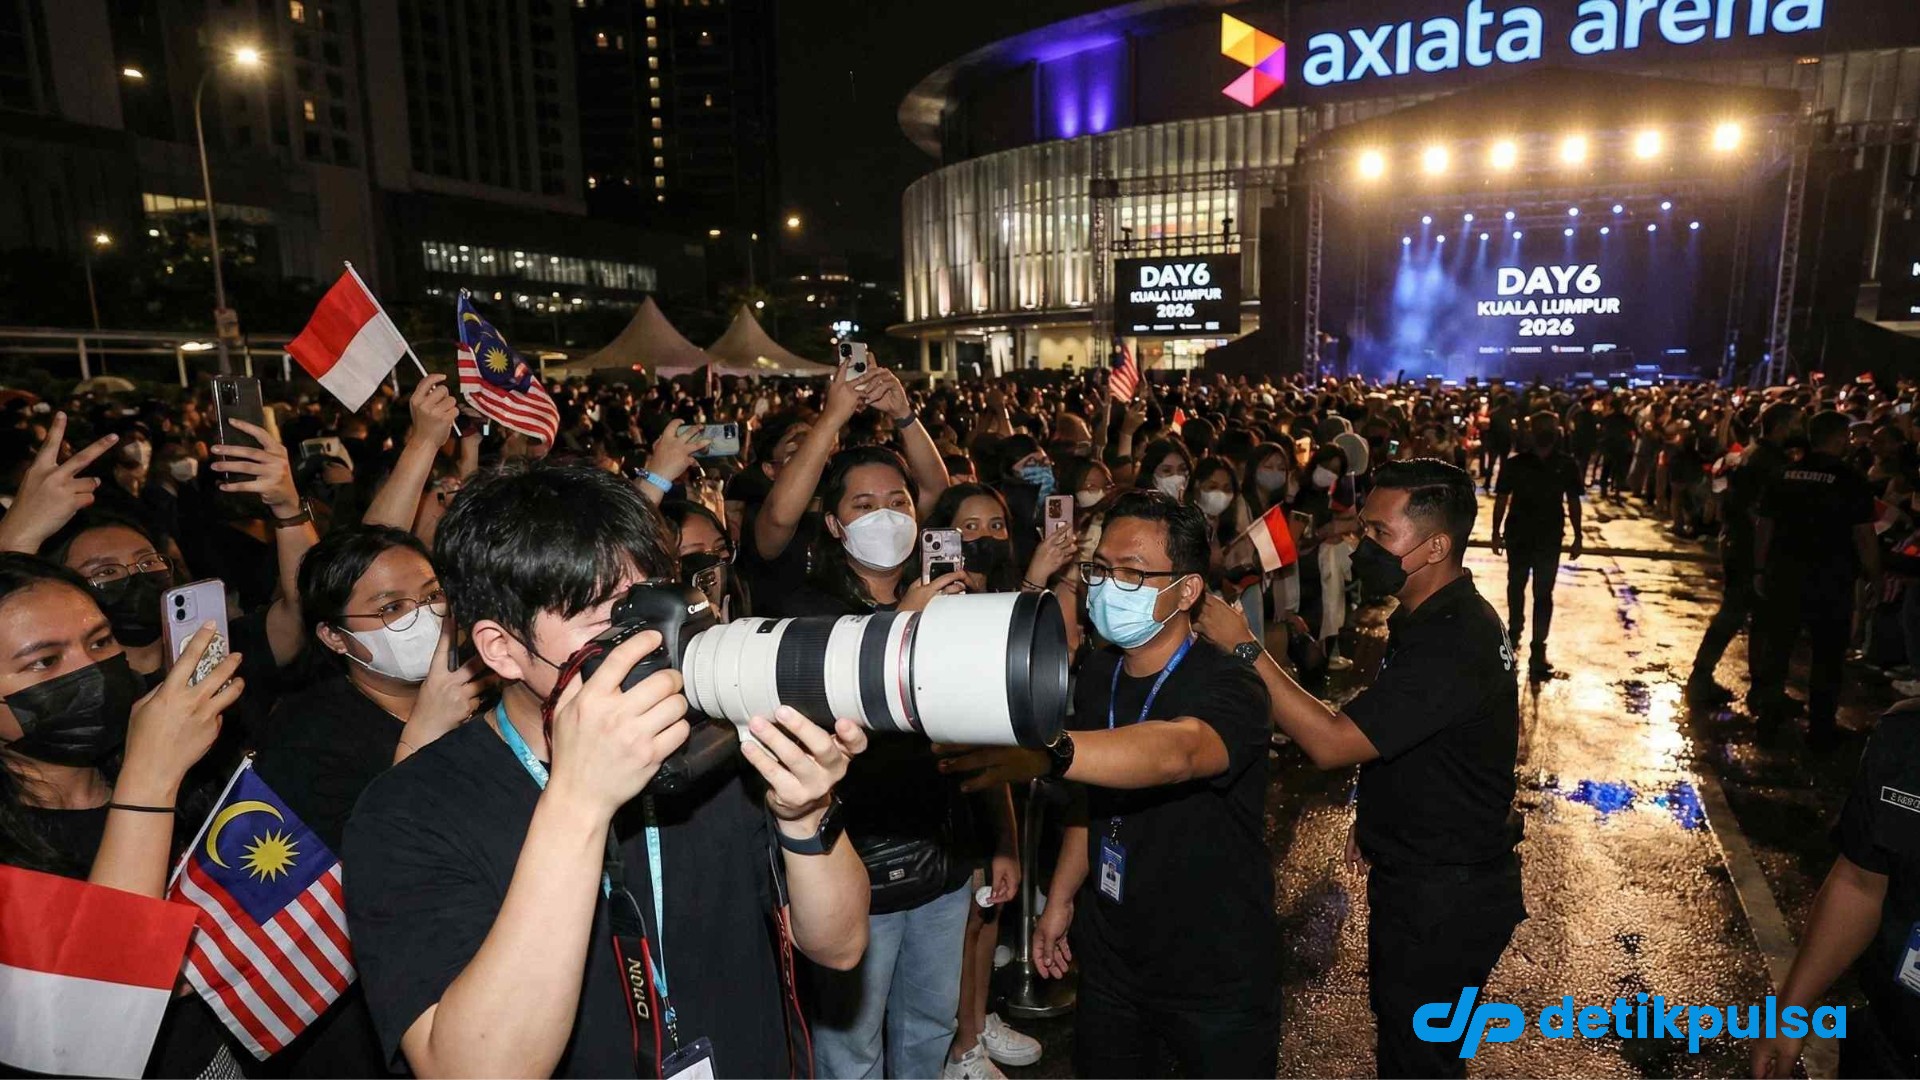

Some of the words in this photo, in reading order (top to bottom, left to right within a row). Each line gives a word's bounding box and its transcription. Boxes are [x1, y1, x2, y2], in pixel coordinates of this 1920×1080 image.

[1302, 0, 1543, 86] axiata
[1570, 0, 1824, 55] arena
[1140, 263, 1211, 288] DAY6
[1497, 264, 1602, 296] DAY6
[1130, 290, 1171, 303] KUALA
[1172, 288, 1222, 301] LUMPUR
[1156, 303, 1195, 318] 2026
[1477, 299, 1539, 316] KUALA
[1541, 297, 1621, 315] LUMPUR
[1518, 318, 1575, 336] 2026
